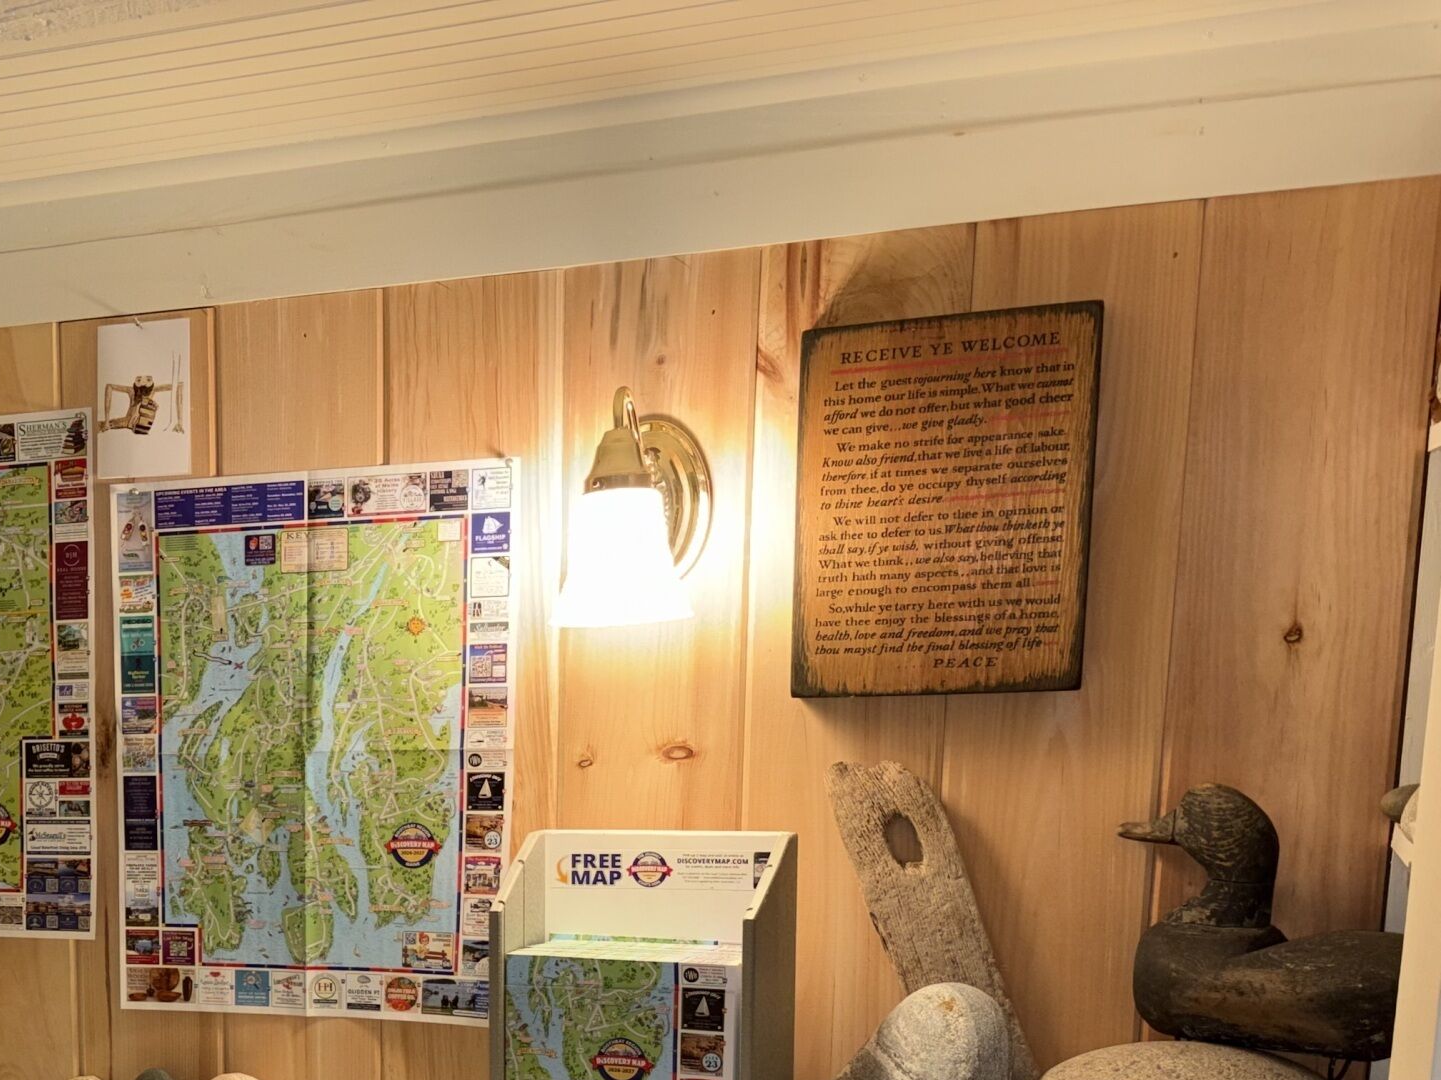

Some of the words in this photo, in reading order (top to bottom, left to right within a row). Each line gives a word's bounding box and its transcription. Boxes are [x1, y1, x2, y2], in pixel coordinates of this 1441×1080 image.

[840, 345, 921, 364] RECEIVE
[929, 342, 953, 355] YE
[960, 332, 1060, 353] WELCOME
[835, 379, 854, 390] Let
[857, 378, 876, 388] the
[880, 374, 912, 390] guest
[913, 371, 971, 386] sojourning
[973, 368, 996, 378] here
[999, 366, 1032, 376] know
[1036, 361, 1060, 373] that
[1063, 362, 1074, 370] in
[823, 396, 845, 406] this
[848, 394, 881, 404] home
[884, 393, 905, 401] our
[907, 388, 925, 399] life
[927, 389, 937, 397] is
[1017, 382, 1034, 390] we
[1036, 375, 1074, 388] cannot
[823, 408, 858, 423] afford
[879, 406, 892, 416] do
[895, 404, 915, 415] not
[950, 399, 970, 410] but
[973, 397, 1001, 408] what
[1005, 394, 1035, 410] good
[1039, 392, 1073, 403] cheer
[19, 420, 68, 436] SHERMAN'S
[920, 419, 944, 431] give
[946, 414, 986, 429] gladly.
[836, 441, 855, 451] We
[858, 439, 890, 450] make
[913, 435, 944, 446] strife
[947, 433, 965, 443] for
[967, 431, 1033, 445] appearance
[822, 458, 853, 467] Know
[855, 455, 876, 465] also
[963, 448, 982, 457] live
[994, 445, 1013, 455] life
[1015, 443, 1029, 453] of
[820, 486, 845, 495] from
[880, 482, 895, 491] do
[899, 483, 913, 494] ye
[918, 480, 961, 491] occupy
[966, 474, 1007, 489] thyself
[1010, 471, 1066, 483] according
[475, 534, 506, 542] FLAGSHIP
[816, 587, 843, 599] large
[848, 584, 891, 597] enough
[895, 583, 907, 592] to
[911, 583, 976, 594] encompass
[980, 579, 1011, 589] them
[854, 630, 876, 639] love
[879, 628, 904, 638] and
[1003, 627, 1031, 637] pray
[1035, 623, 1058, 633] that
[933, 657, 998, 667] PEACE
[390, 841, 421, 849] DISCOVERY
[422, 841, 436, 849] MAP
[487, 838, 498, 846] 23
[571, 854, 622, 869] FREE
[571, 870, 622, 885] MAP
[596, 1057, 631, 1065] DISCOVERY
[632, 1059, 646, 1067] MAP
[706, 1061, 718, 1069] 23
